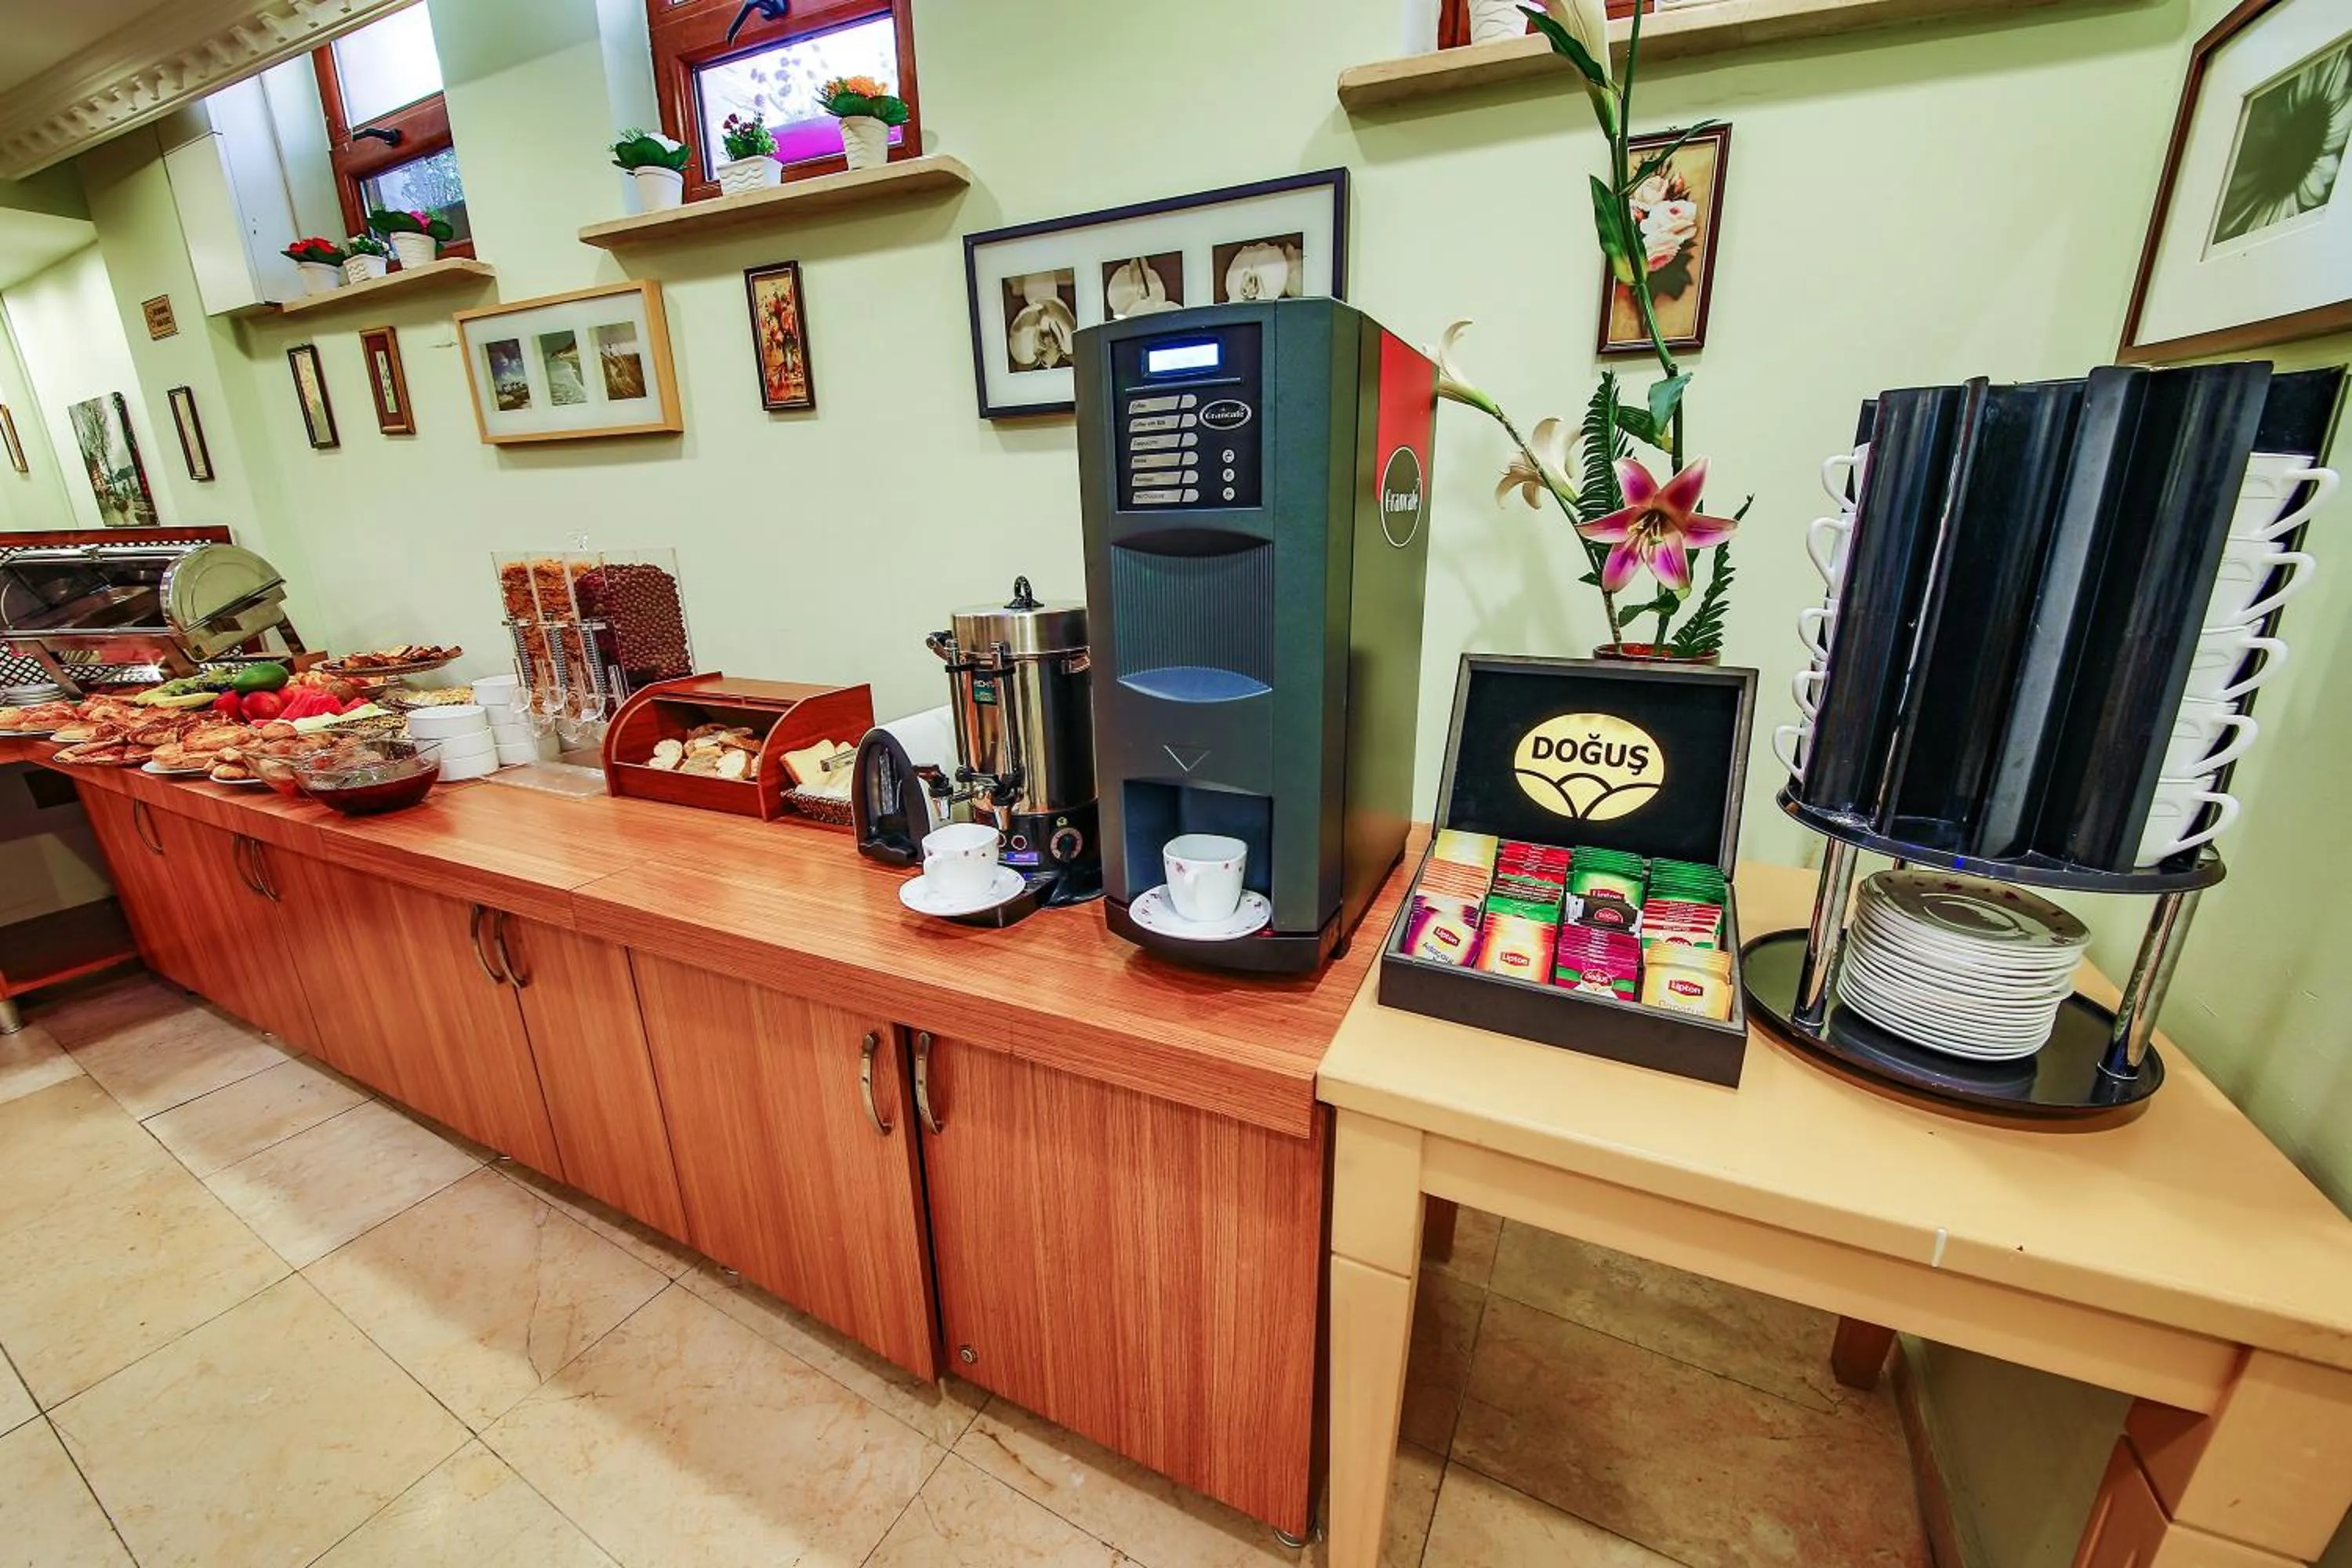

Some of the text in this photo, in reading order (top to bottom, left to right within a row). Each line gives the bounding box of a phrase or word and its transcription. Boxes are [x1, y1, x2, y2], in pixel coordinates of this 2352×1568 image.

[1531, 733, 1650, 775] DOĞUŞ
[1436, 927, 1458, 945] Lipton
[1503, 953, 1528, 965] Lipton
[1671, 981, 1700, 994] Lipton
